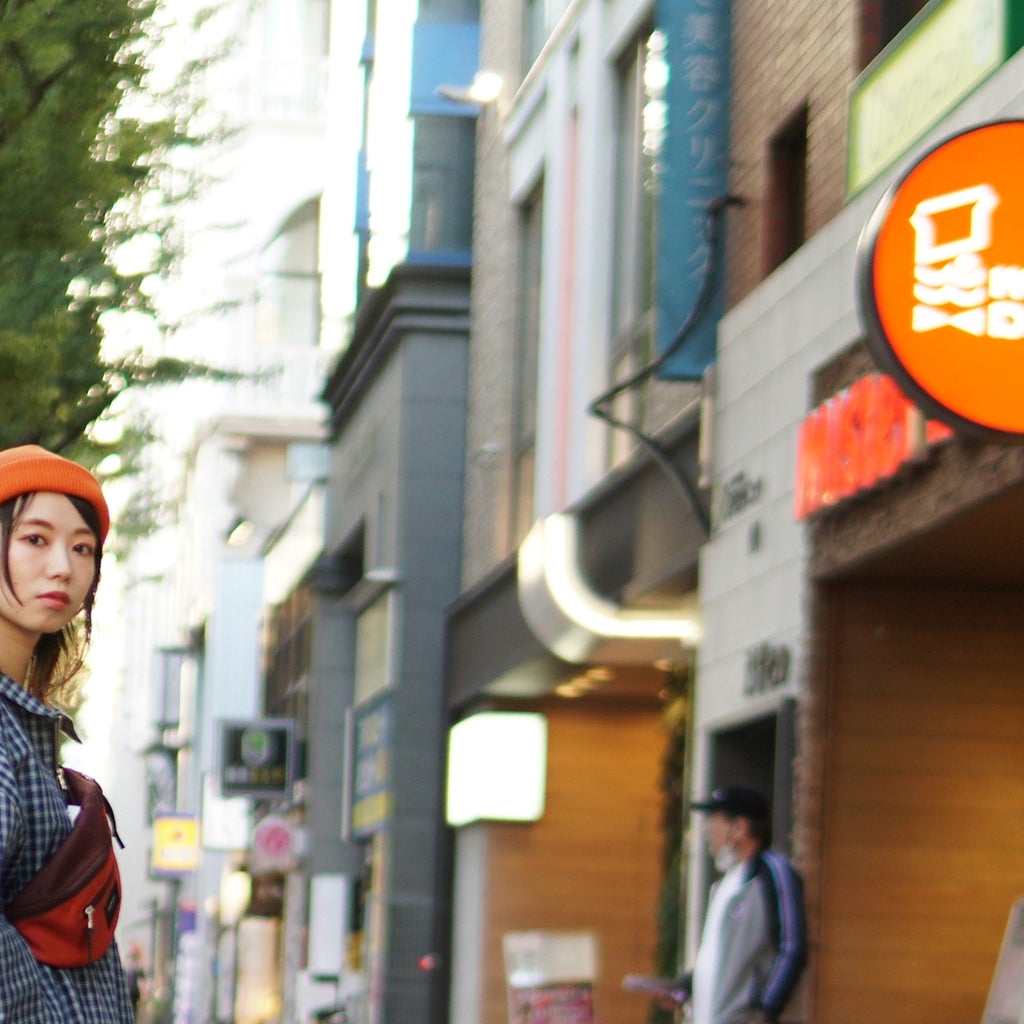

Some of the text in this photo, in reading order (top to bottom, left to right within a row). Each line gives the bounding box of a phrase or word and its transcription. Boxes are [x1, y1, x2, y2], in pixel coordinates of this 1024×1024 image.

[681, 0, 719, 281] 美容クリニック
